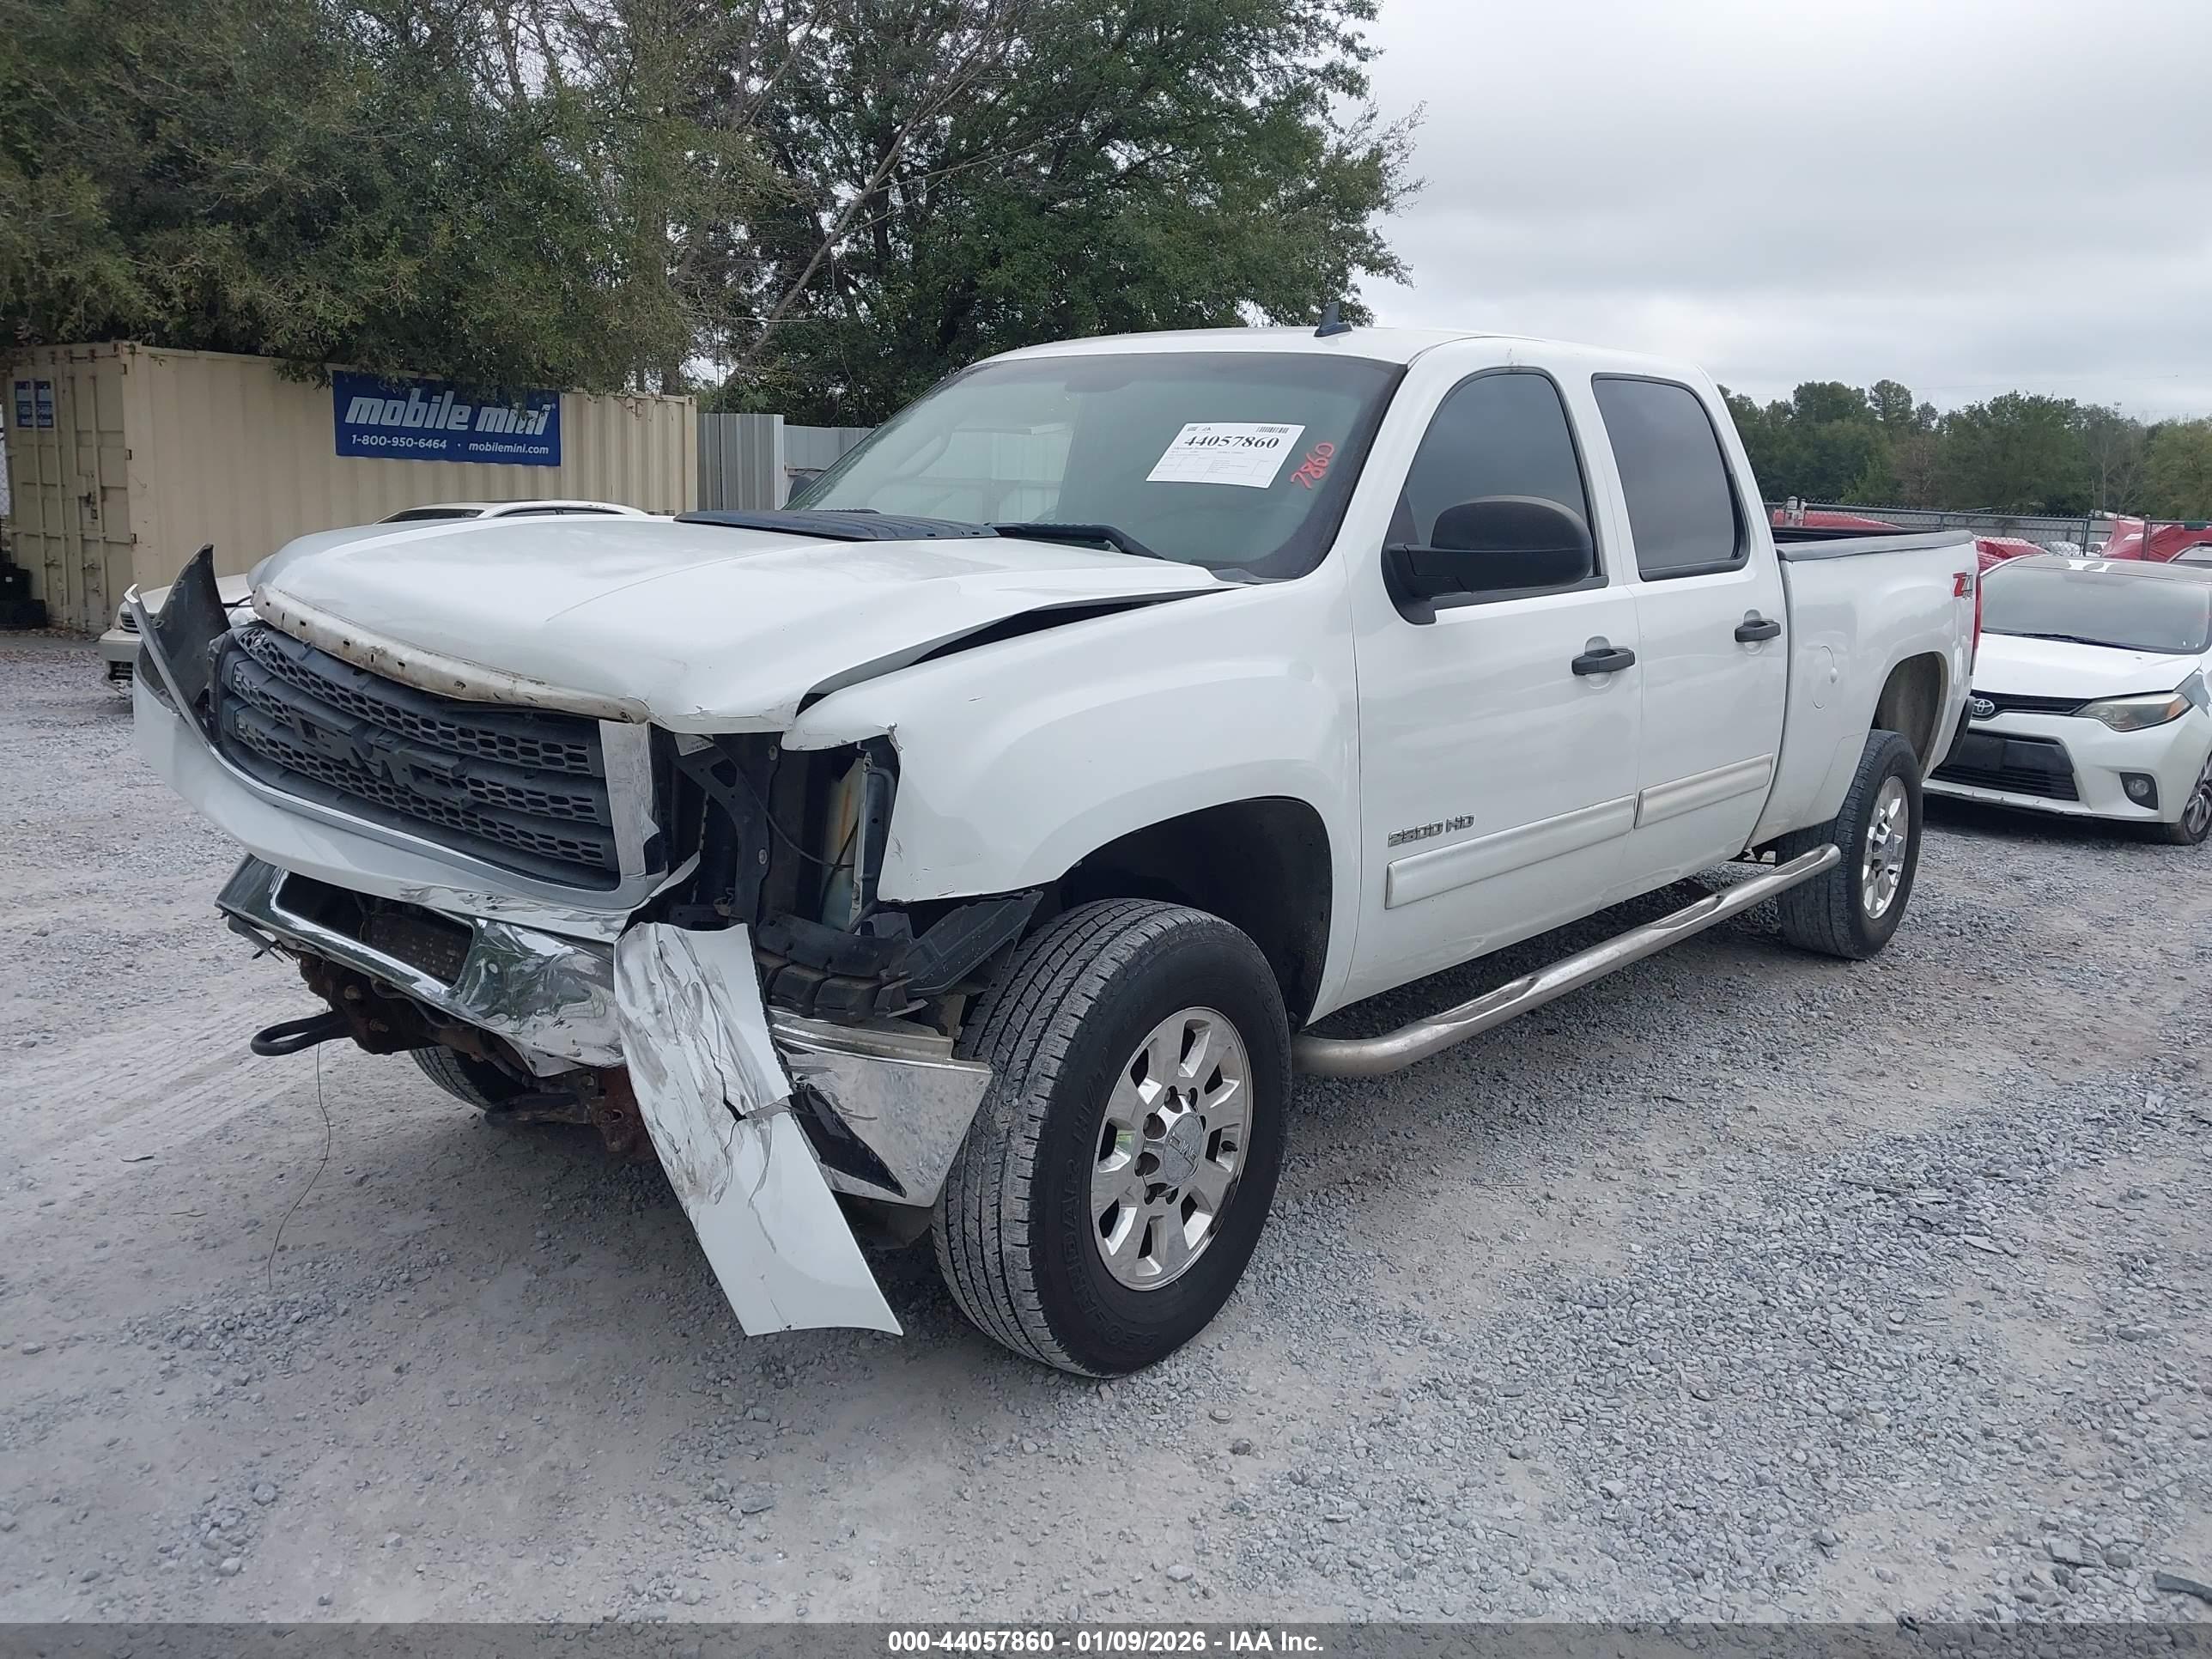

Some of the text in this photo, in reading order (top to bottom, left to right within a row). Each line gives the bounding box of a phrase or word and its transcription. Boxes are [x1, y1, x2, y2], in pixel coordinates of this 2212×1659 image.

[345, 388, 550, 435] mobile mini
[351, 434, 550, 455] 1-800-950-6464 mobilemini.com
[1184, 435, 1279, 449] 44057860
[1290, 442, 1335, 489] 7860
[1388, 814, 1475, 848] 2500 HD
